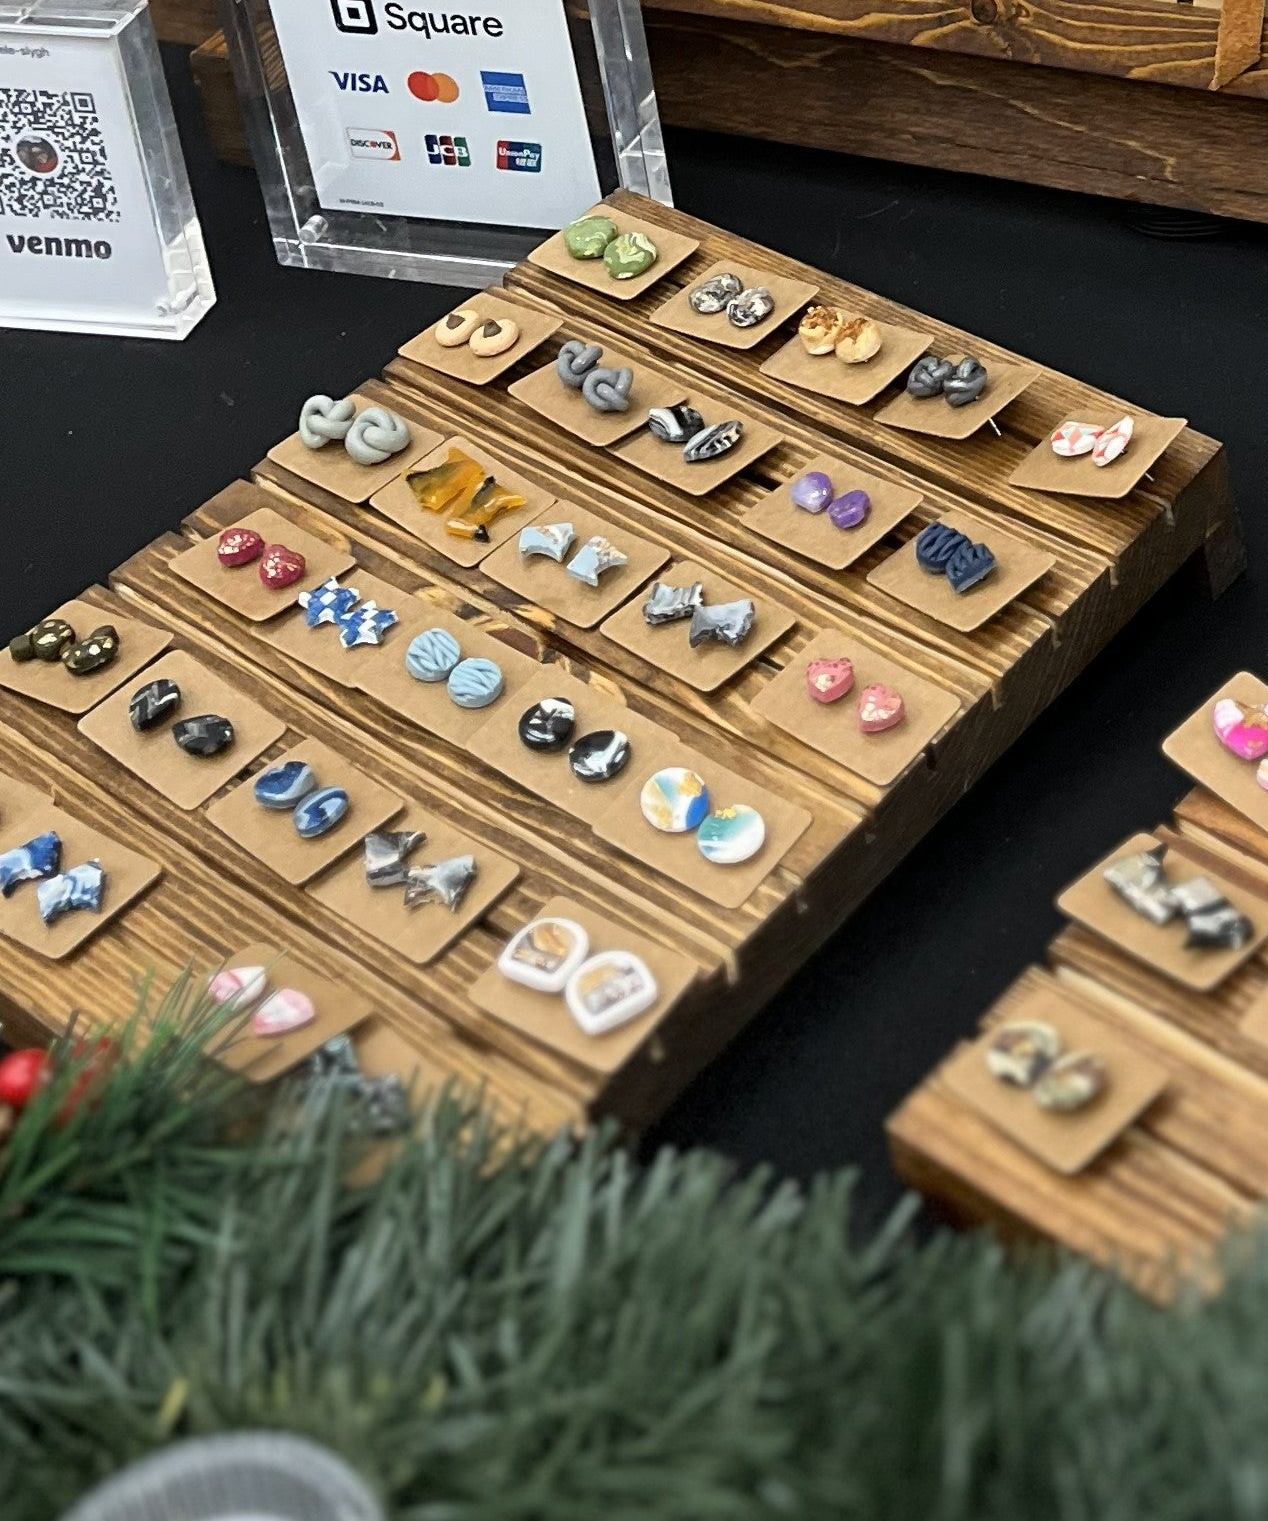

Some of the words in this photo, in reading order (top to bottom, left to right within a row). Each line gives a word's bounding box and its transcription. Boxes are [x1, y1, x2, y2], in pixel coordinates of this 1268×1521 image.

[384, 1, 504, 40] Square
[328, 70, 390, 94] VISA
[425, 144, 470, 158] JCB
[498, 146, 541, 161] UnionPay
[6, 234, 113, 260] venmo
